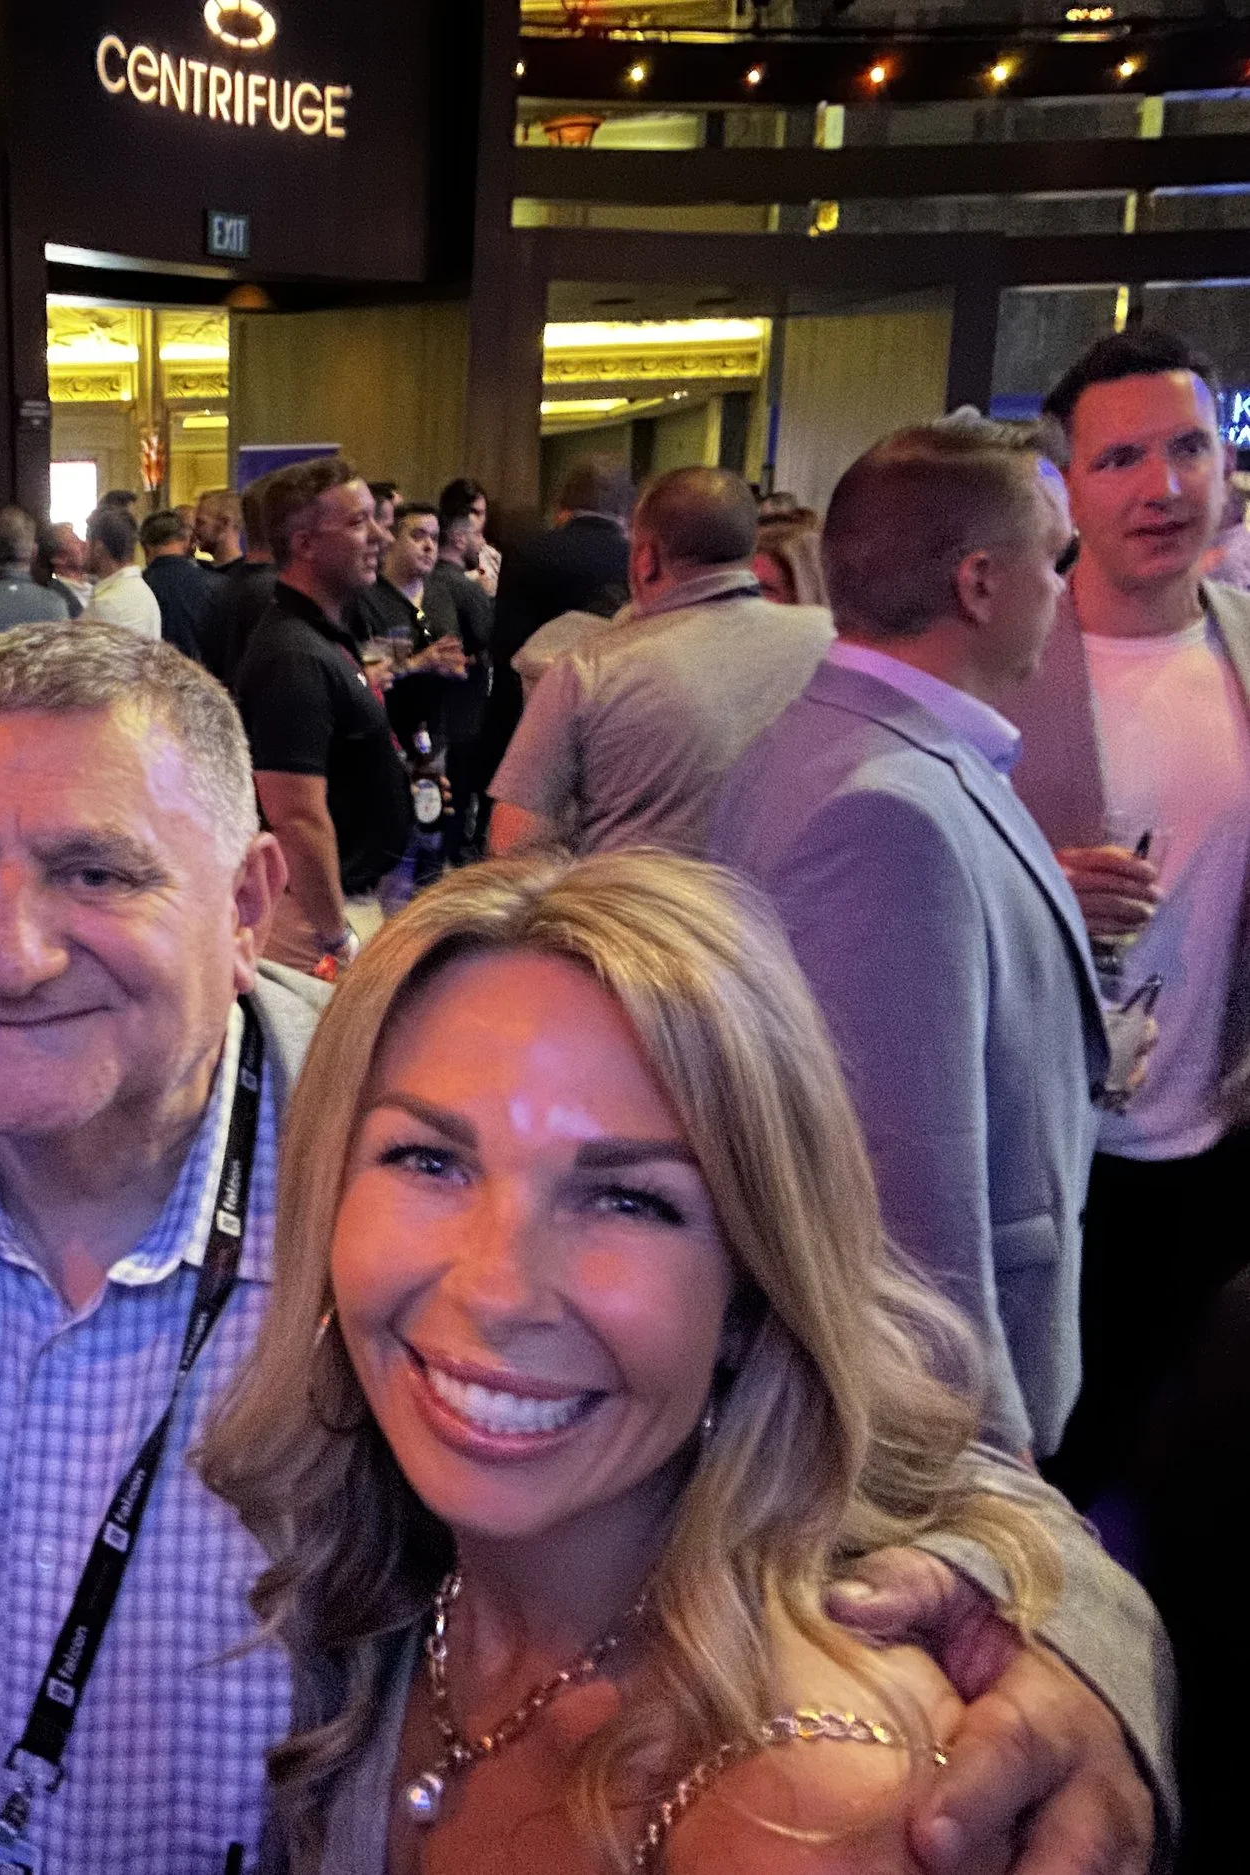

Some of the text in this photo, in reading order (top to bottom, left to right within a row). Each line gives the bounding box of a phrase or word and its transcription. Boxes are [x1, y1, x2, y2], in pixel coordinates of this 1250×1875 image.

[213, 216, 246, 251] EXIT
[114, 1468, 146, 1524] falcon
[56, 1624, 90, 1681] falcon
